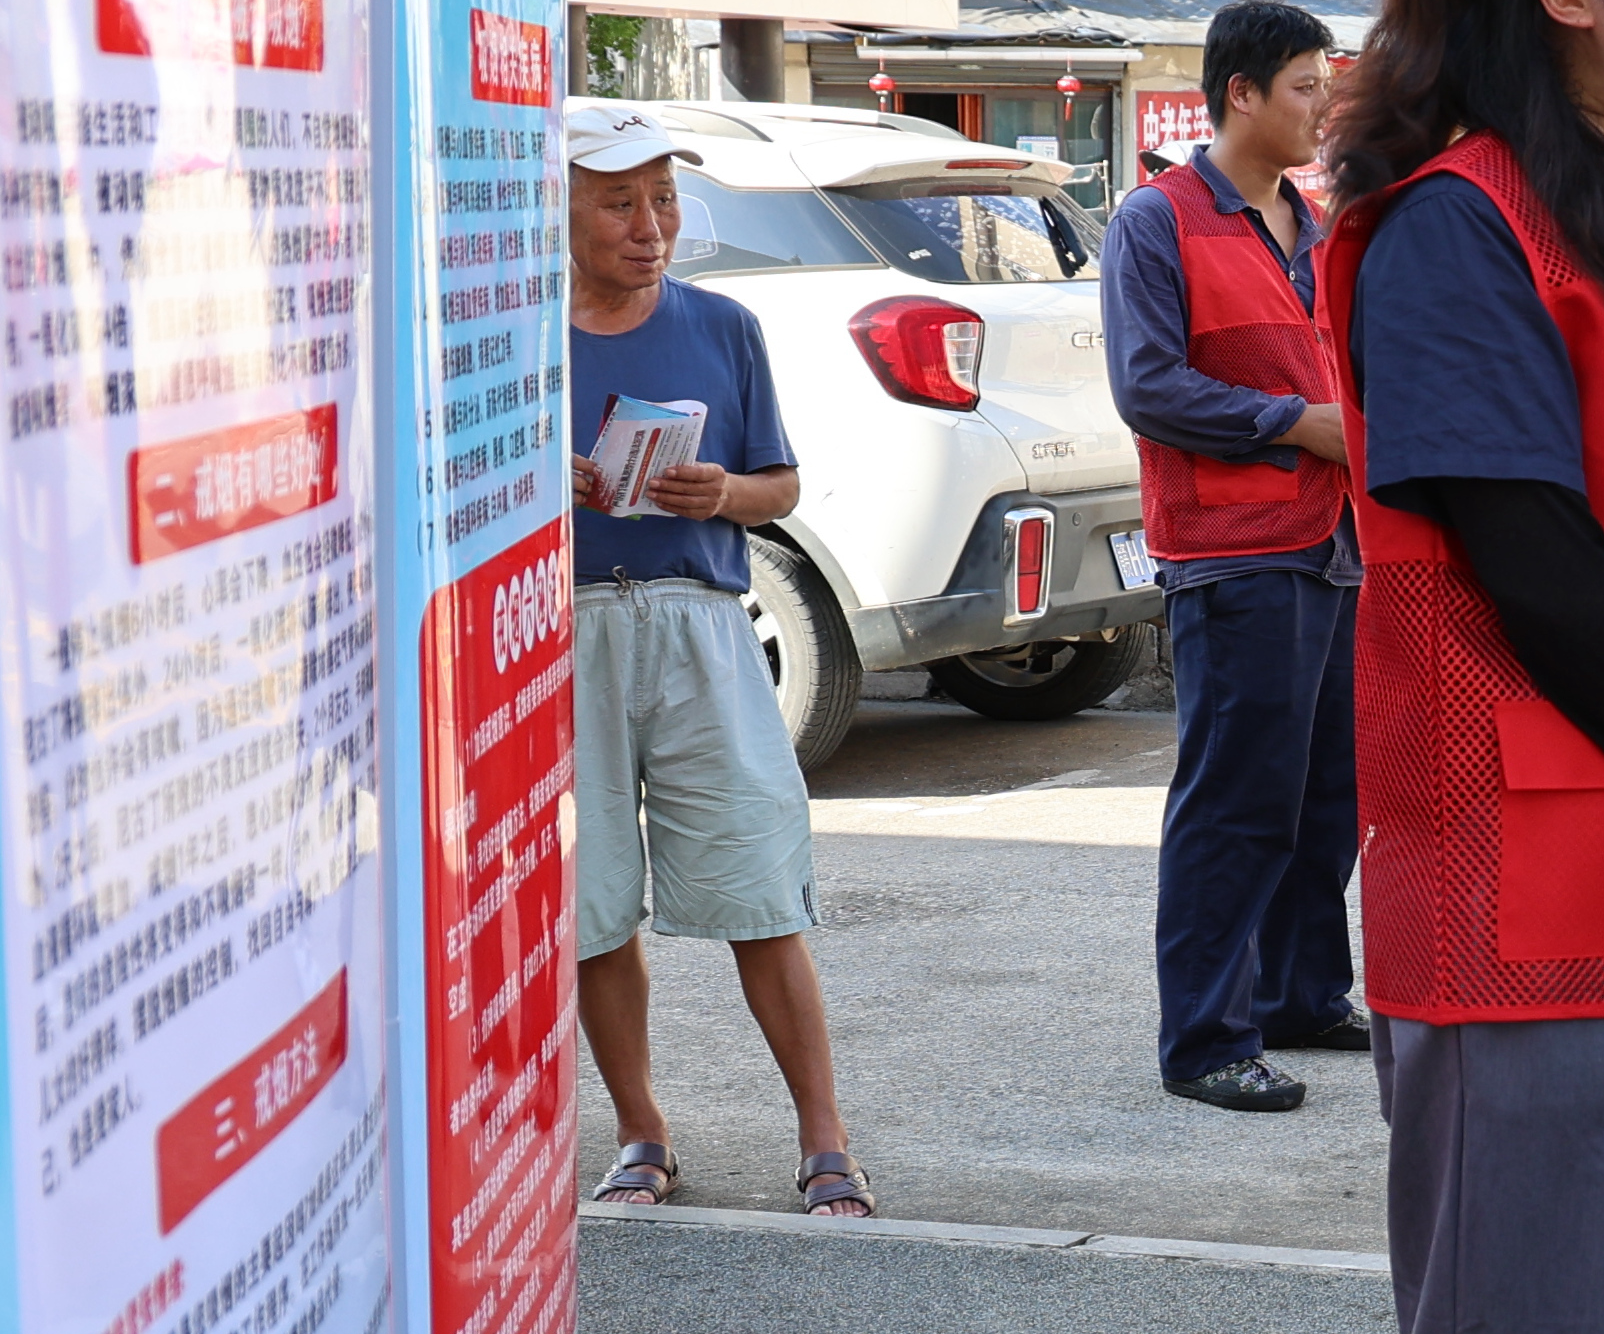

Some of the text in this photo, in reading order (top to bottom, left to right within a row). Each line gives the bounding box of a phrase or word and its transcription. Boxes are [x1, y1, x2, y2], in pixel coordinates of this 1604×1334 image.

[214, 1023, 320, 1163] 三、戒烟方法
